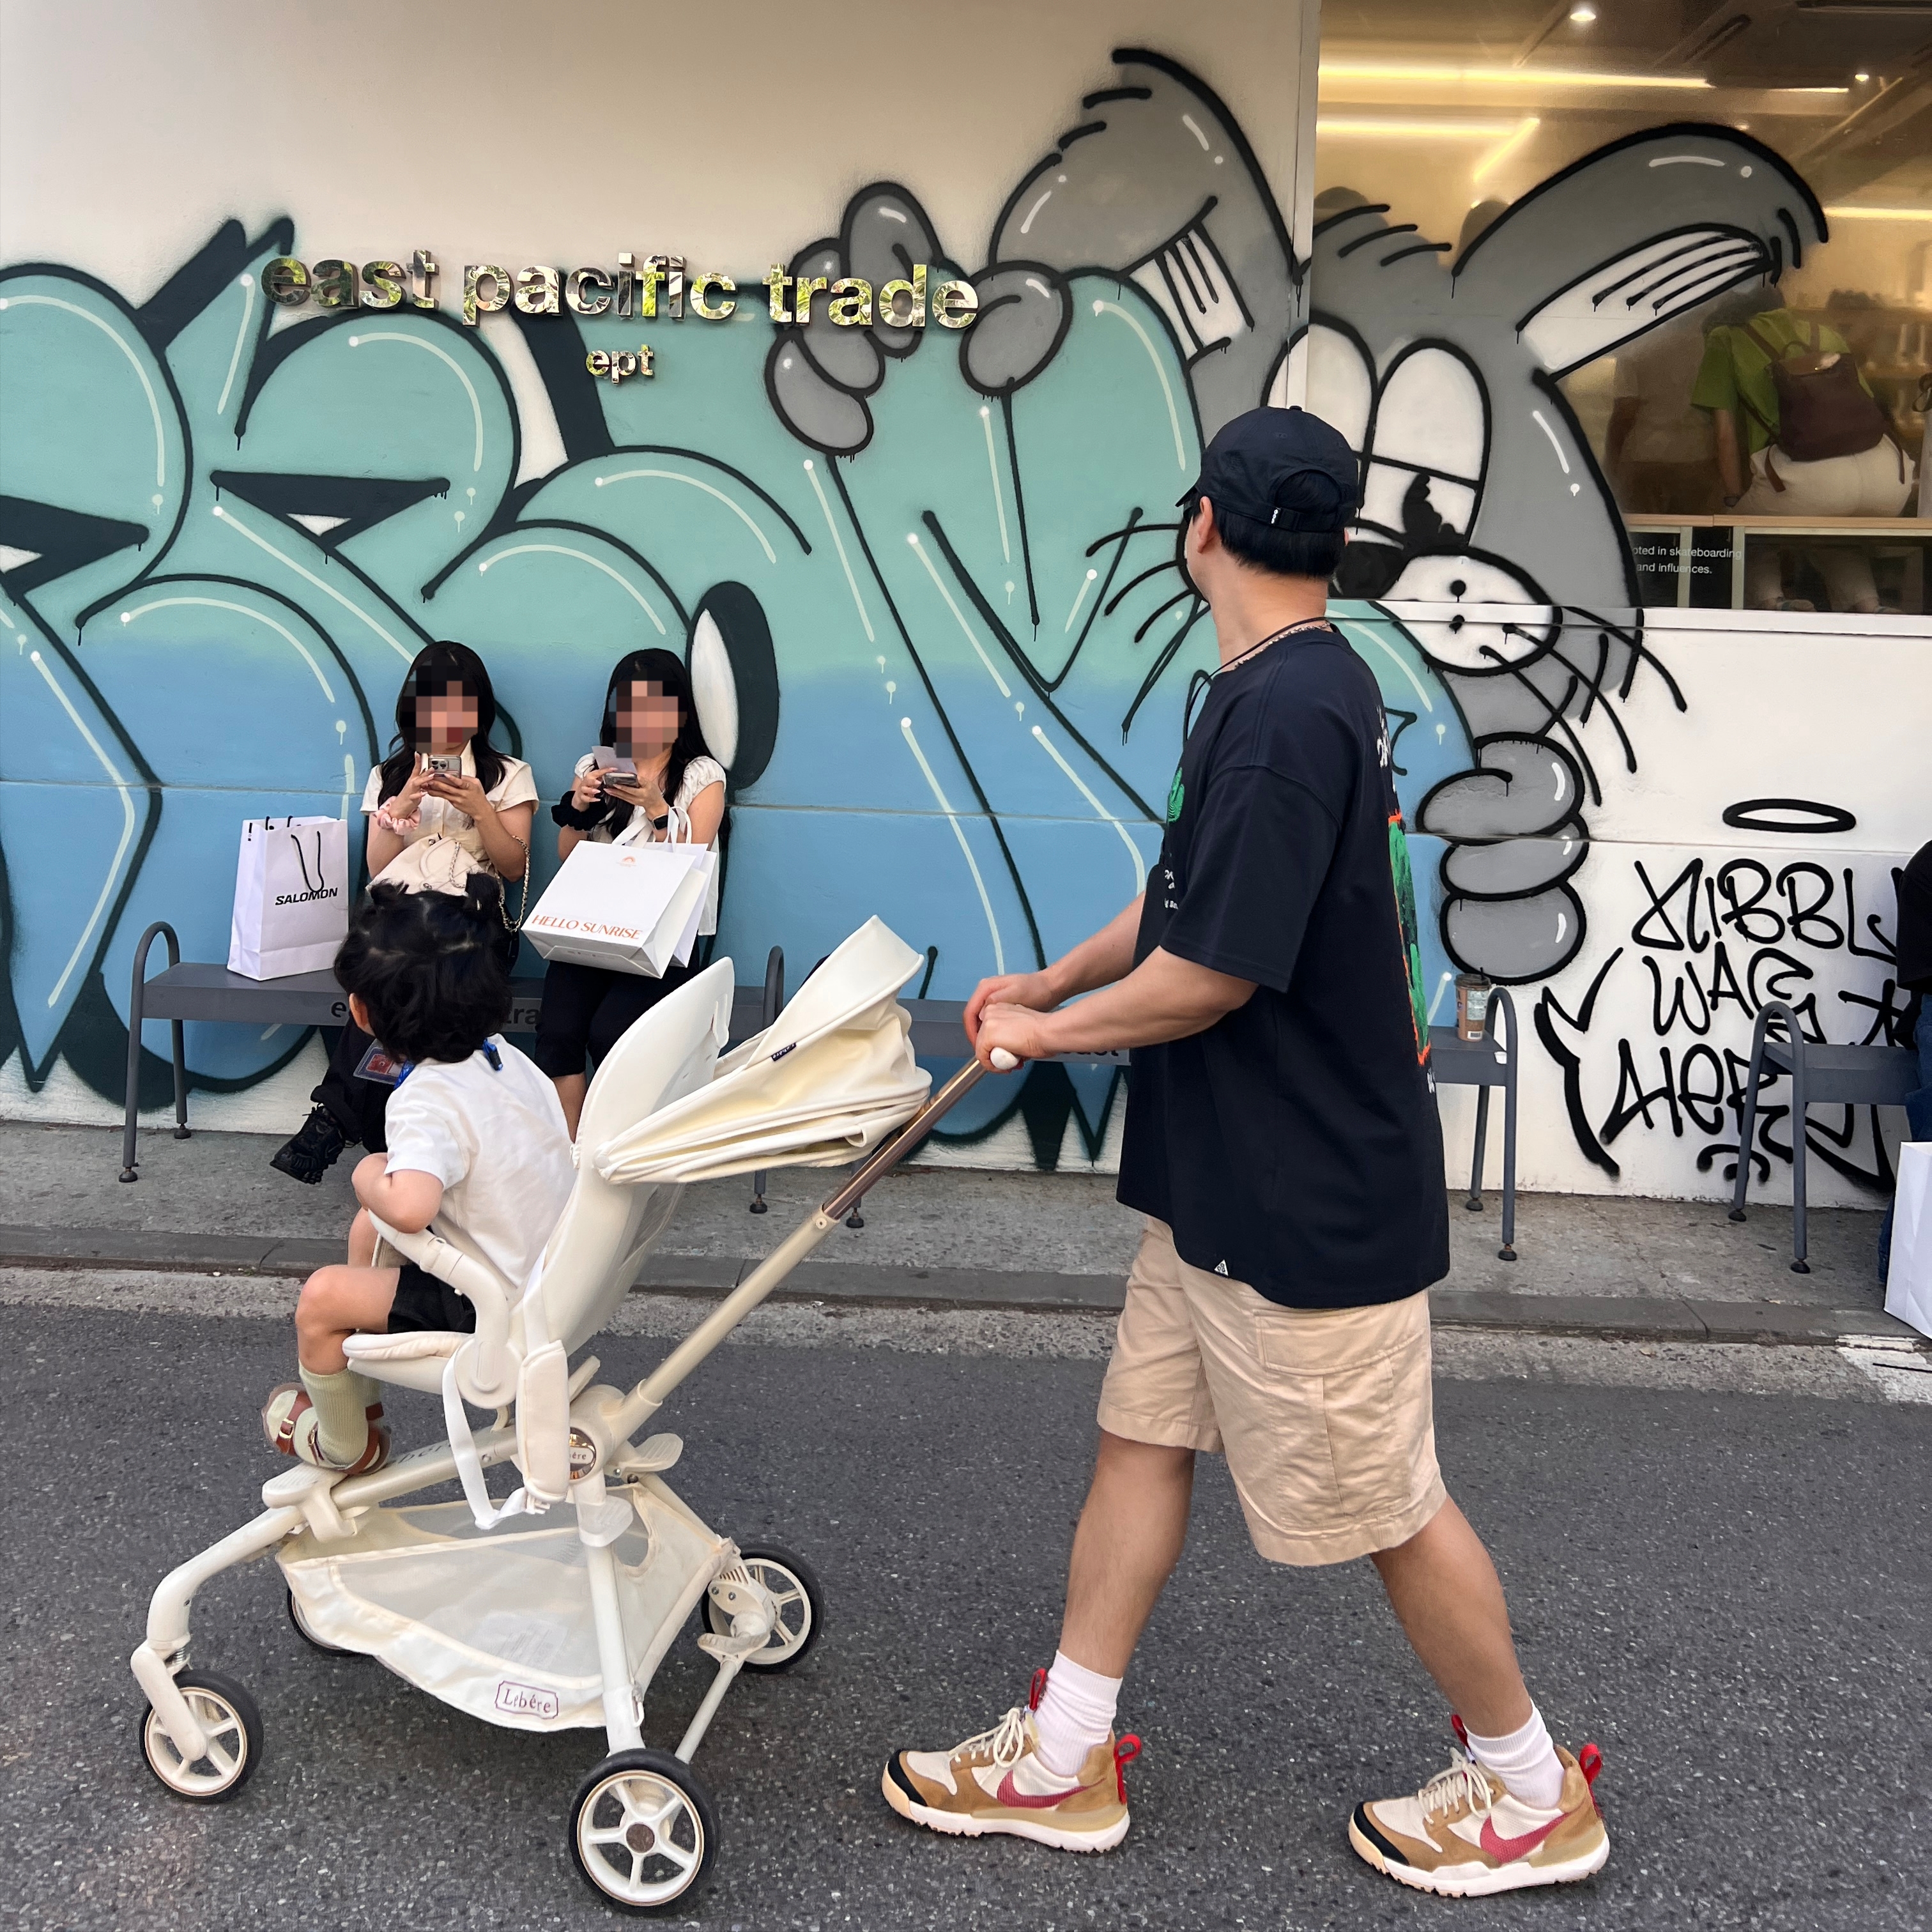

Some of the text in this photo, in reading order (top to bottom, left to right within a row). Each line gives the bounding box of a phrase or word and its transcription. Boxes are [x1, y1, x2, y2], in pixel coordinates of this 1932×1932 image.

[261, 250, 980, 330] east pacific trade
[585, 344, 656, 385] ept
[1632, 546, 1742, 560] oted in skateboarding
[1637, 563, 1712, 574] and influences.
[275, 887, 338, 906] SALOMON
[532, 915, 643, 940] HELLO SUNRISE
